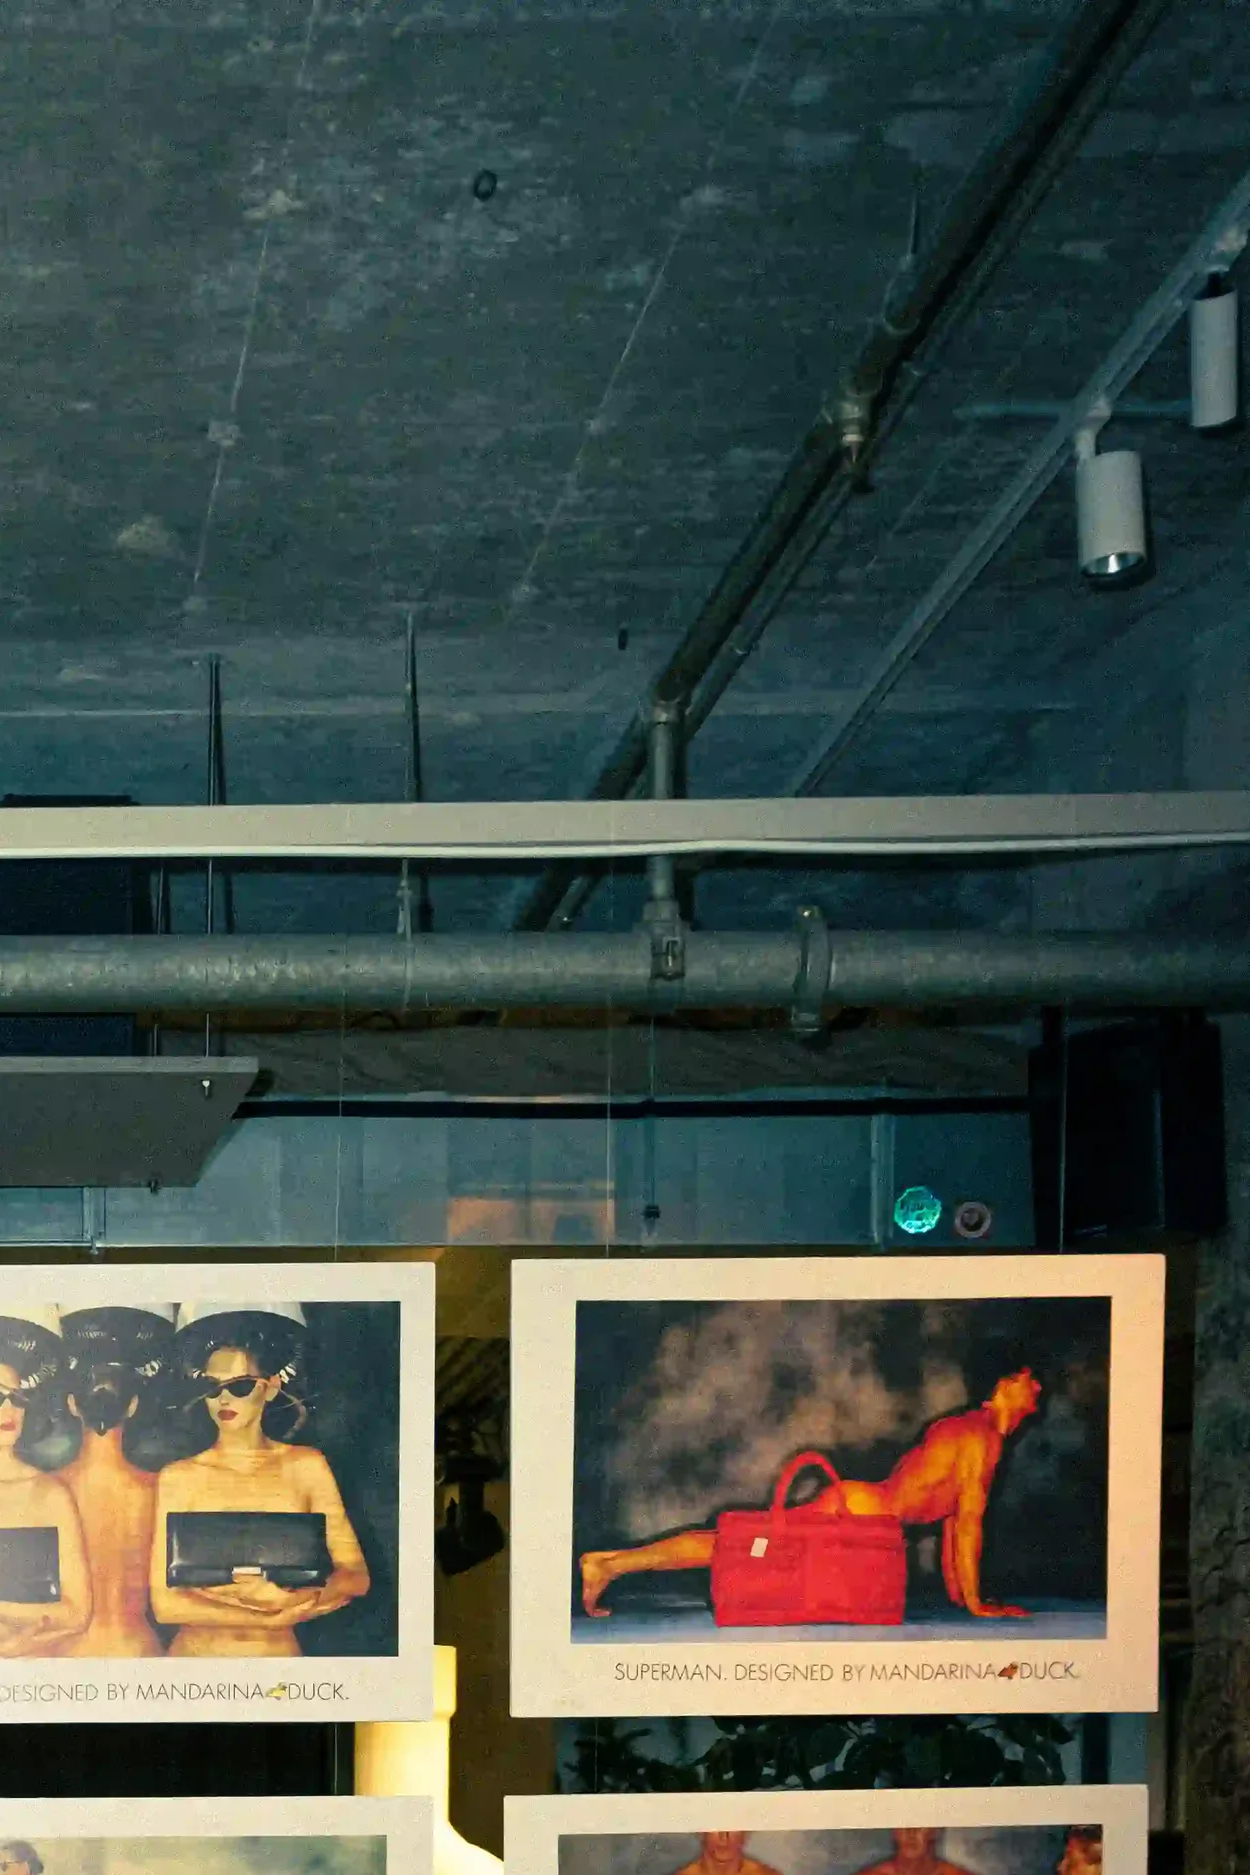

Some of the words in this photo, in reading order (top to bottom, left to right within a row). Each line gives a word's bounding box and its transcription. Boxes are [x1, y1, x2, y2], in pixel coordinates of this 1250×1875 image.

[614, 1662, 728, 1682] SUPERMAN.
[734, 1663, 834, 1682] DESIGNED
[842, 1663, 866, 1682] BY
[869, 1663, 999, 1682] MANDARINA
[106, 1682, 129, 1700] BY
[136, 1682, 265, 1701] MANDARINA
[288, 1682, 350, 1700] DUCK.
